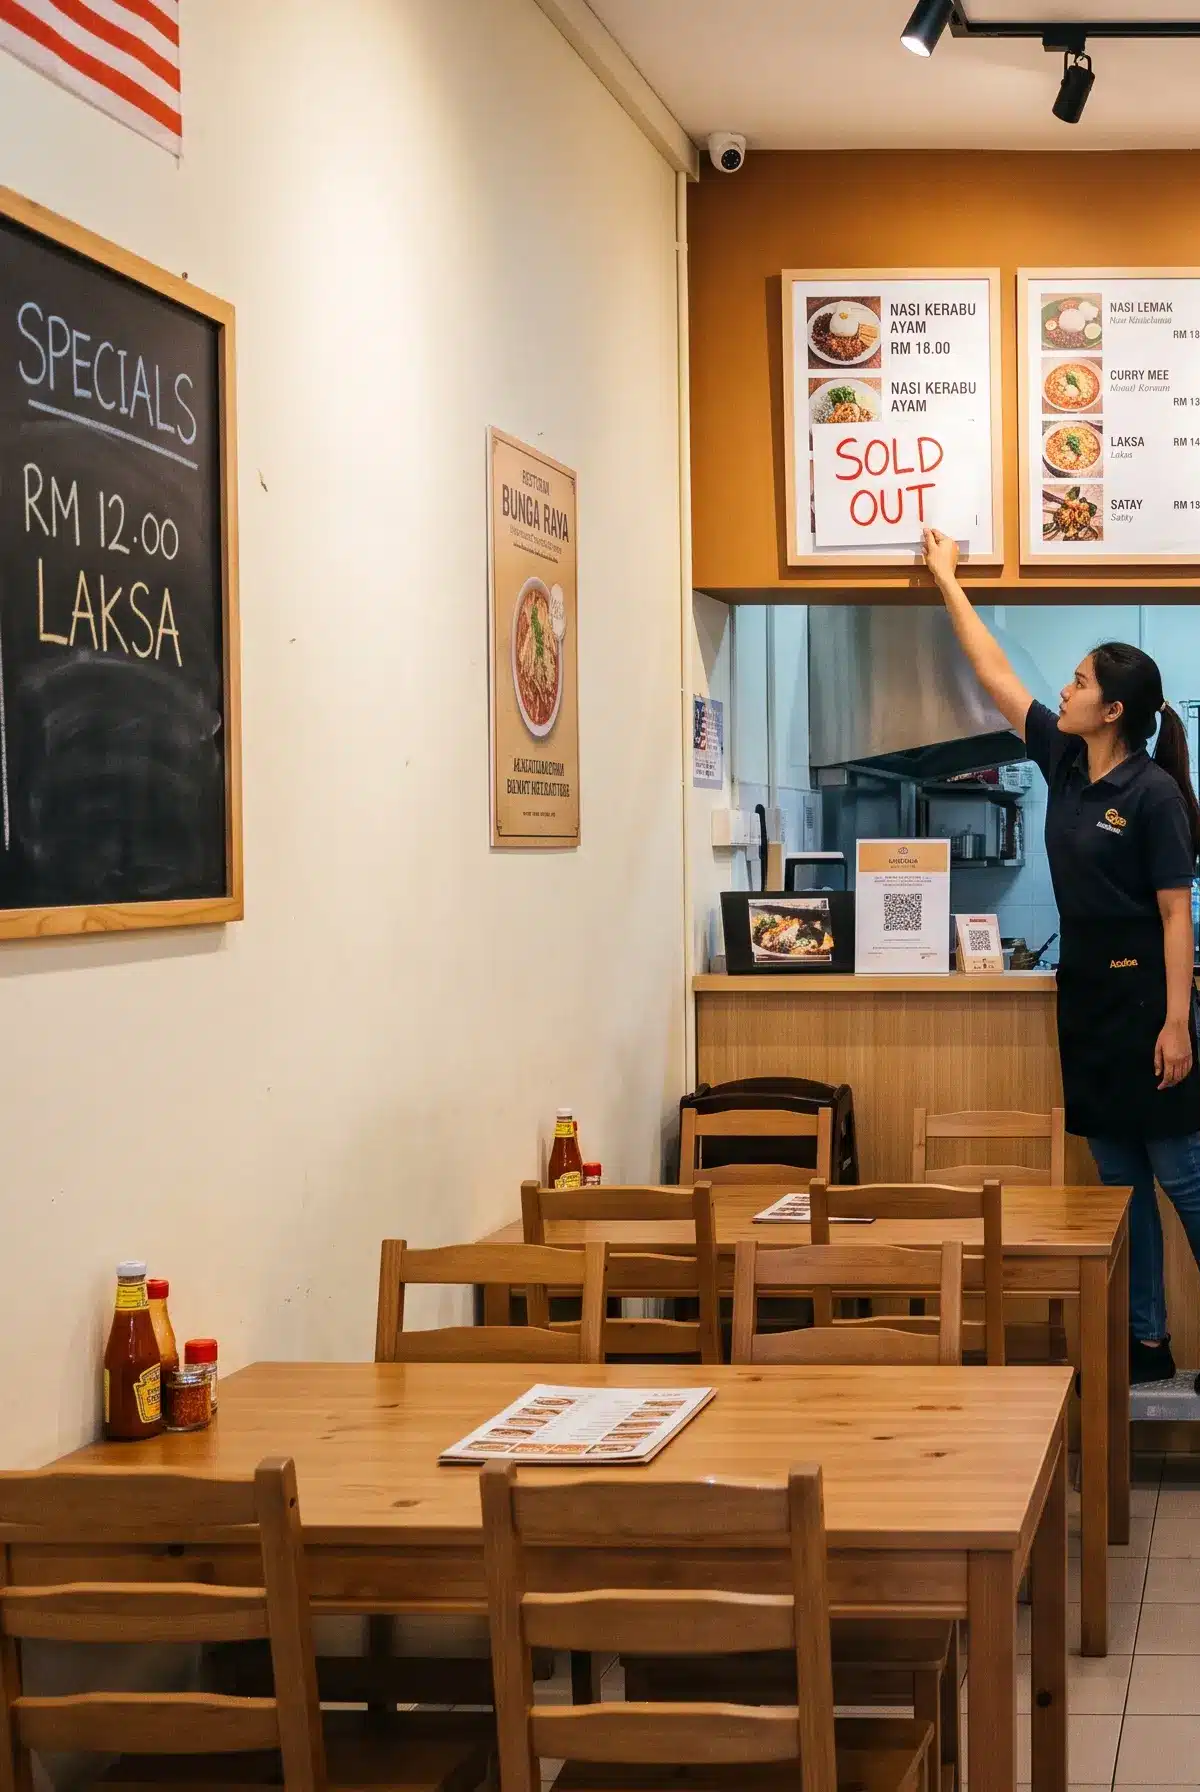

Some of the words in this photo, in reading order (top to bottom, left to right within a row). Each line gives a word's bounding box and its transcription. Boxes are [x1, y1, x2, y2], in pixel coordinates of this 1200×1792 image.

[890, 303, 920, 316] NASI
[925, 303, 976, 316] KERABU
[1110, 302, 1134, 313] NASI
[1137, 302, 1173, 313] LEMAK
[890, 321, 926, 334] AYAM
[1173, 330, 1187, 339] RM
[890, 342, 911, 355] RM
[915, 342, 951, 355] 18.00
[18, 302, 196, 445] SPECIALS
[1110, 370, 1145, 380] CURRY
[1147, 370, 1169, 380] MEE
[891, 382, 921, 395] NASI
[926, 382, 977, 395] KERABU
[891, 400, 927, 412] AYAM
[1173, 397, 1187, 406] RM
[1110, 436, 1145, 447] LAKSA
[1173, 437, 1187, 446] RM
[835, 436, 944, 481] SOLD
[850, 483, 936, 526] OUT
[1110, 499, 1143, 510] SATAY
[1173, 500, 1188, 510] RM
[24, 463, 80, 546] RM
[100, 491, 179, 560] 12.00
[502, 484, 540, 530] BUNGA
[544, 504, 569, 543] RAYA
[38, 557, 183, 667] LAKSA
